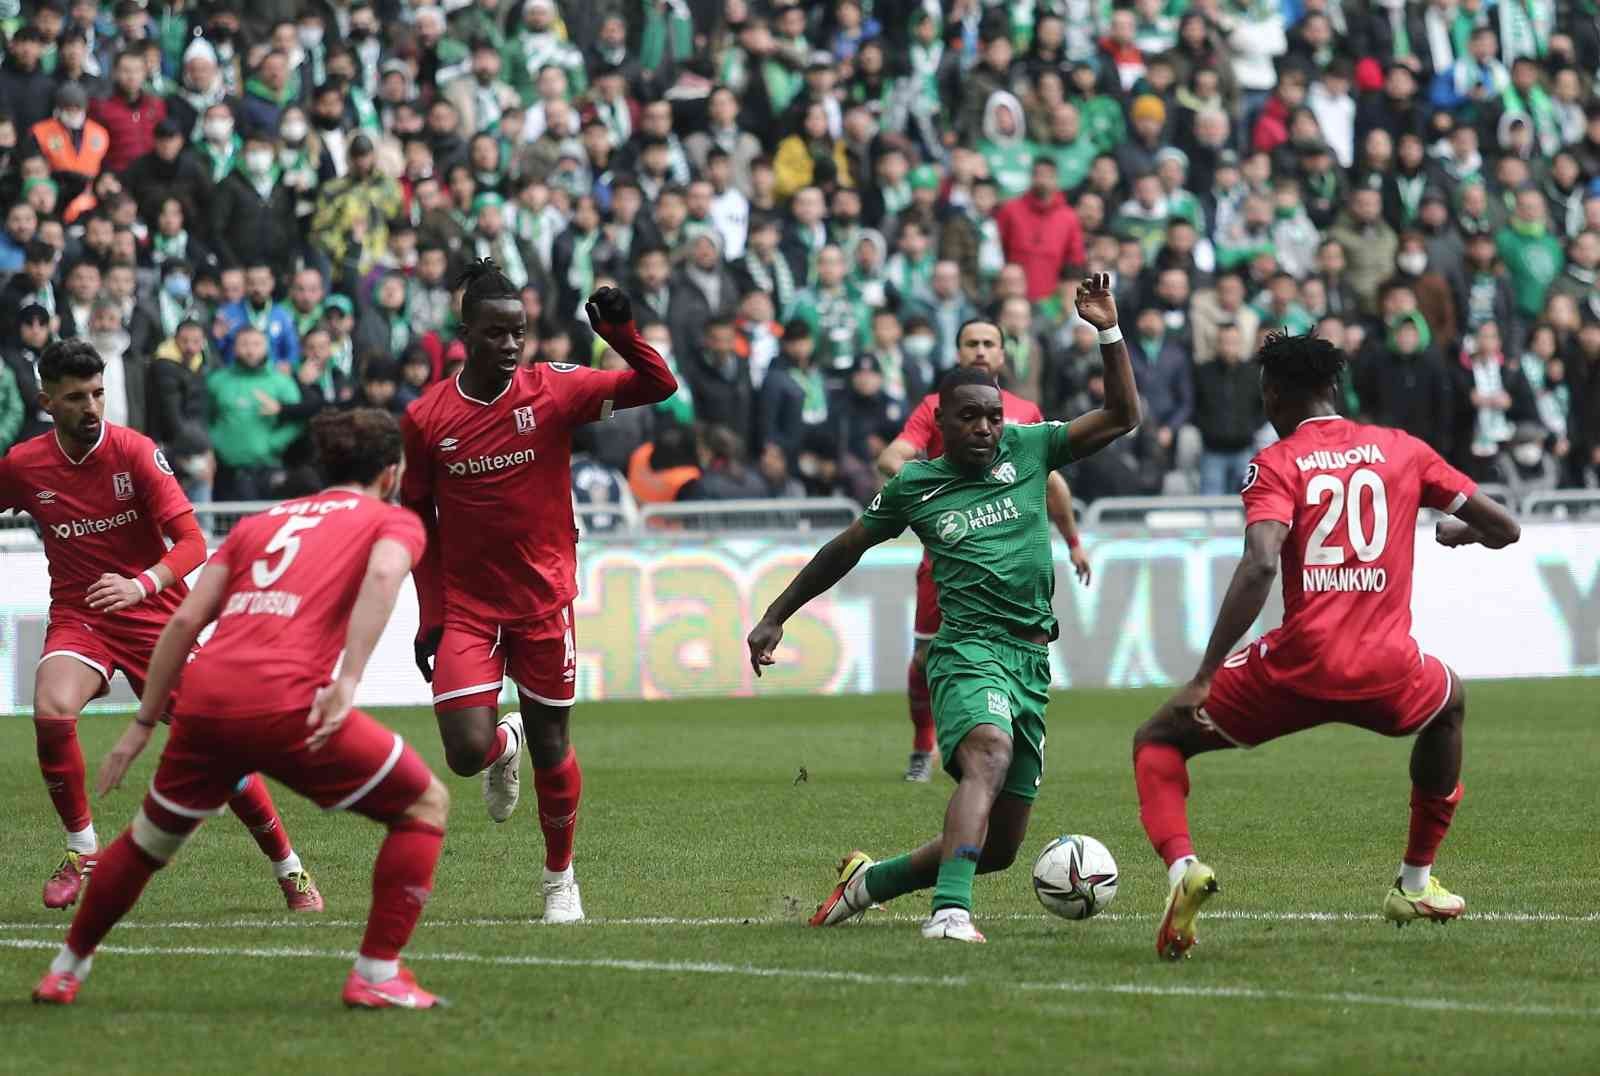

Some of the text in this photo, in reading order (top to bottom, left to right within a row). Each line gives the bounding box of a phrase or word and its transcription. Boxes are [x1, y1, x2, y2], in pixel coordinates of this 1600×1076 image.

[469, 448, 535, 474] bitexen
[965, 496, 1014, 520] TARIM
[1303, 468, 1389, 566] 20
[72, 509, 139, 537] bitexen
[251, 515, 323, 589] 5
[1302, 566, 1387, 593] NWANKWO
